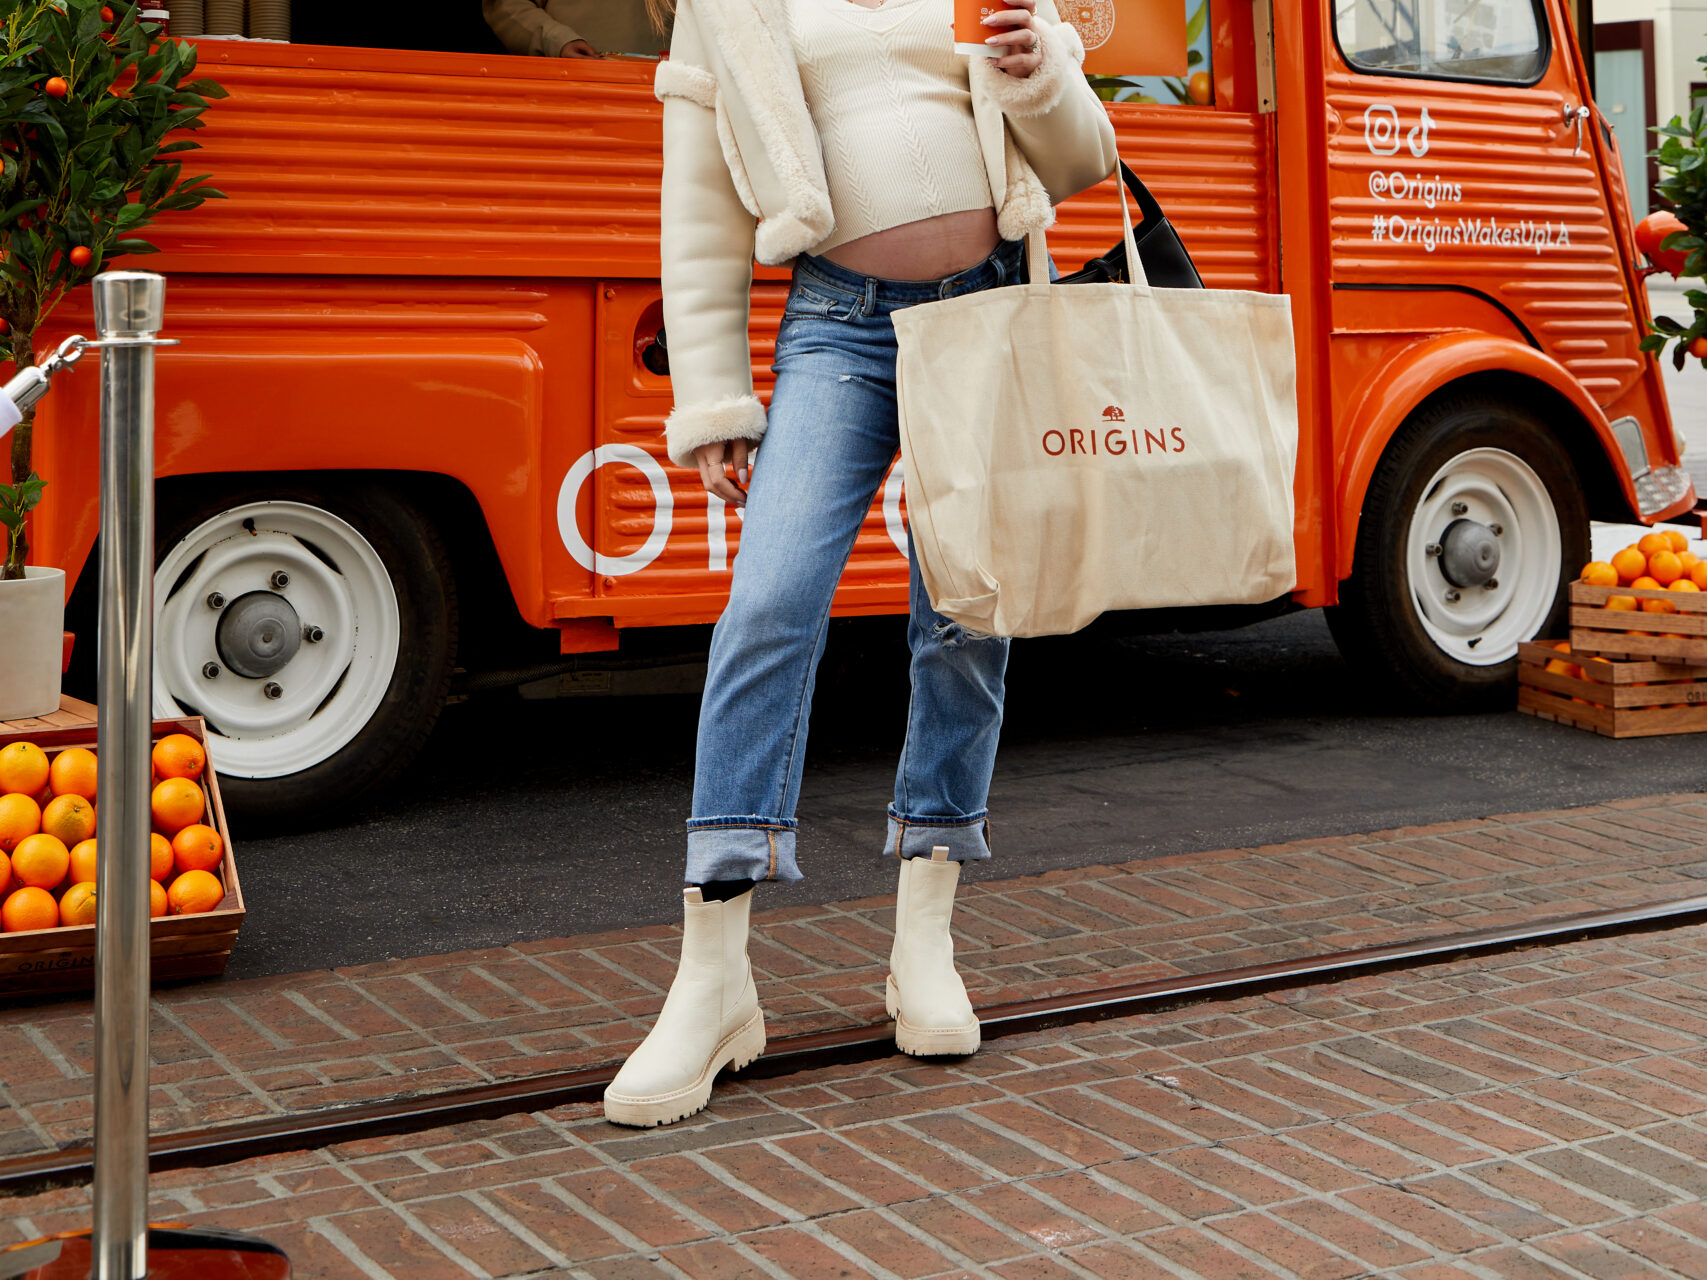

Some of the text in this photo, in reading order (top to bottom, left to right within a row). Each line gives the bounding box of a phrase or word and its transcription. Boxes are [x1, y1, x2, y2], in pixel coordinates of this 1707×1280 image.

[1368, 170, 1462, 209] @Origins
[1371, 215, 1571, 255] #OriginsWakesUpLA
[1042, 426, 1186, 456] ORIGINS
[18, 955, 95, 971] ORIGIN
